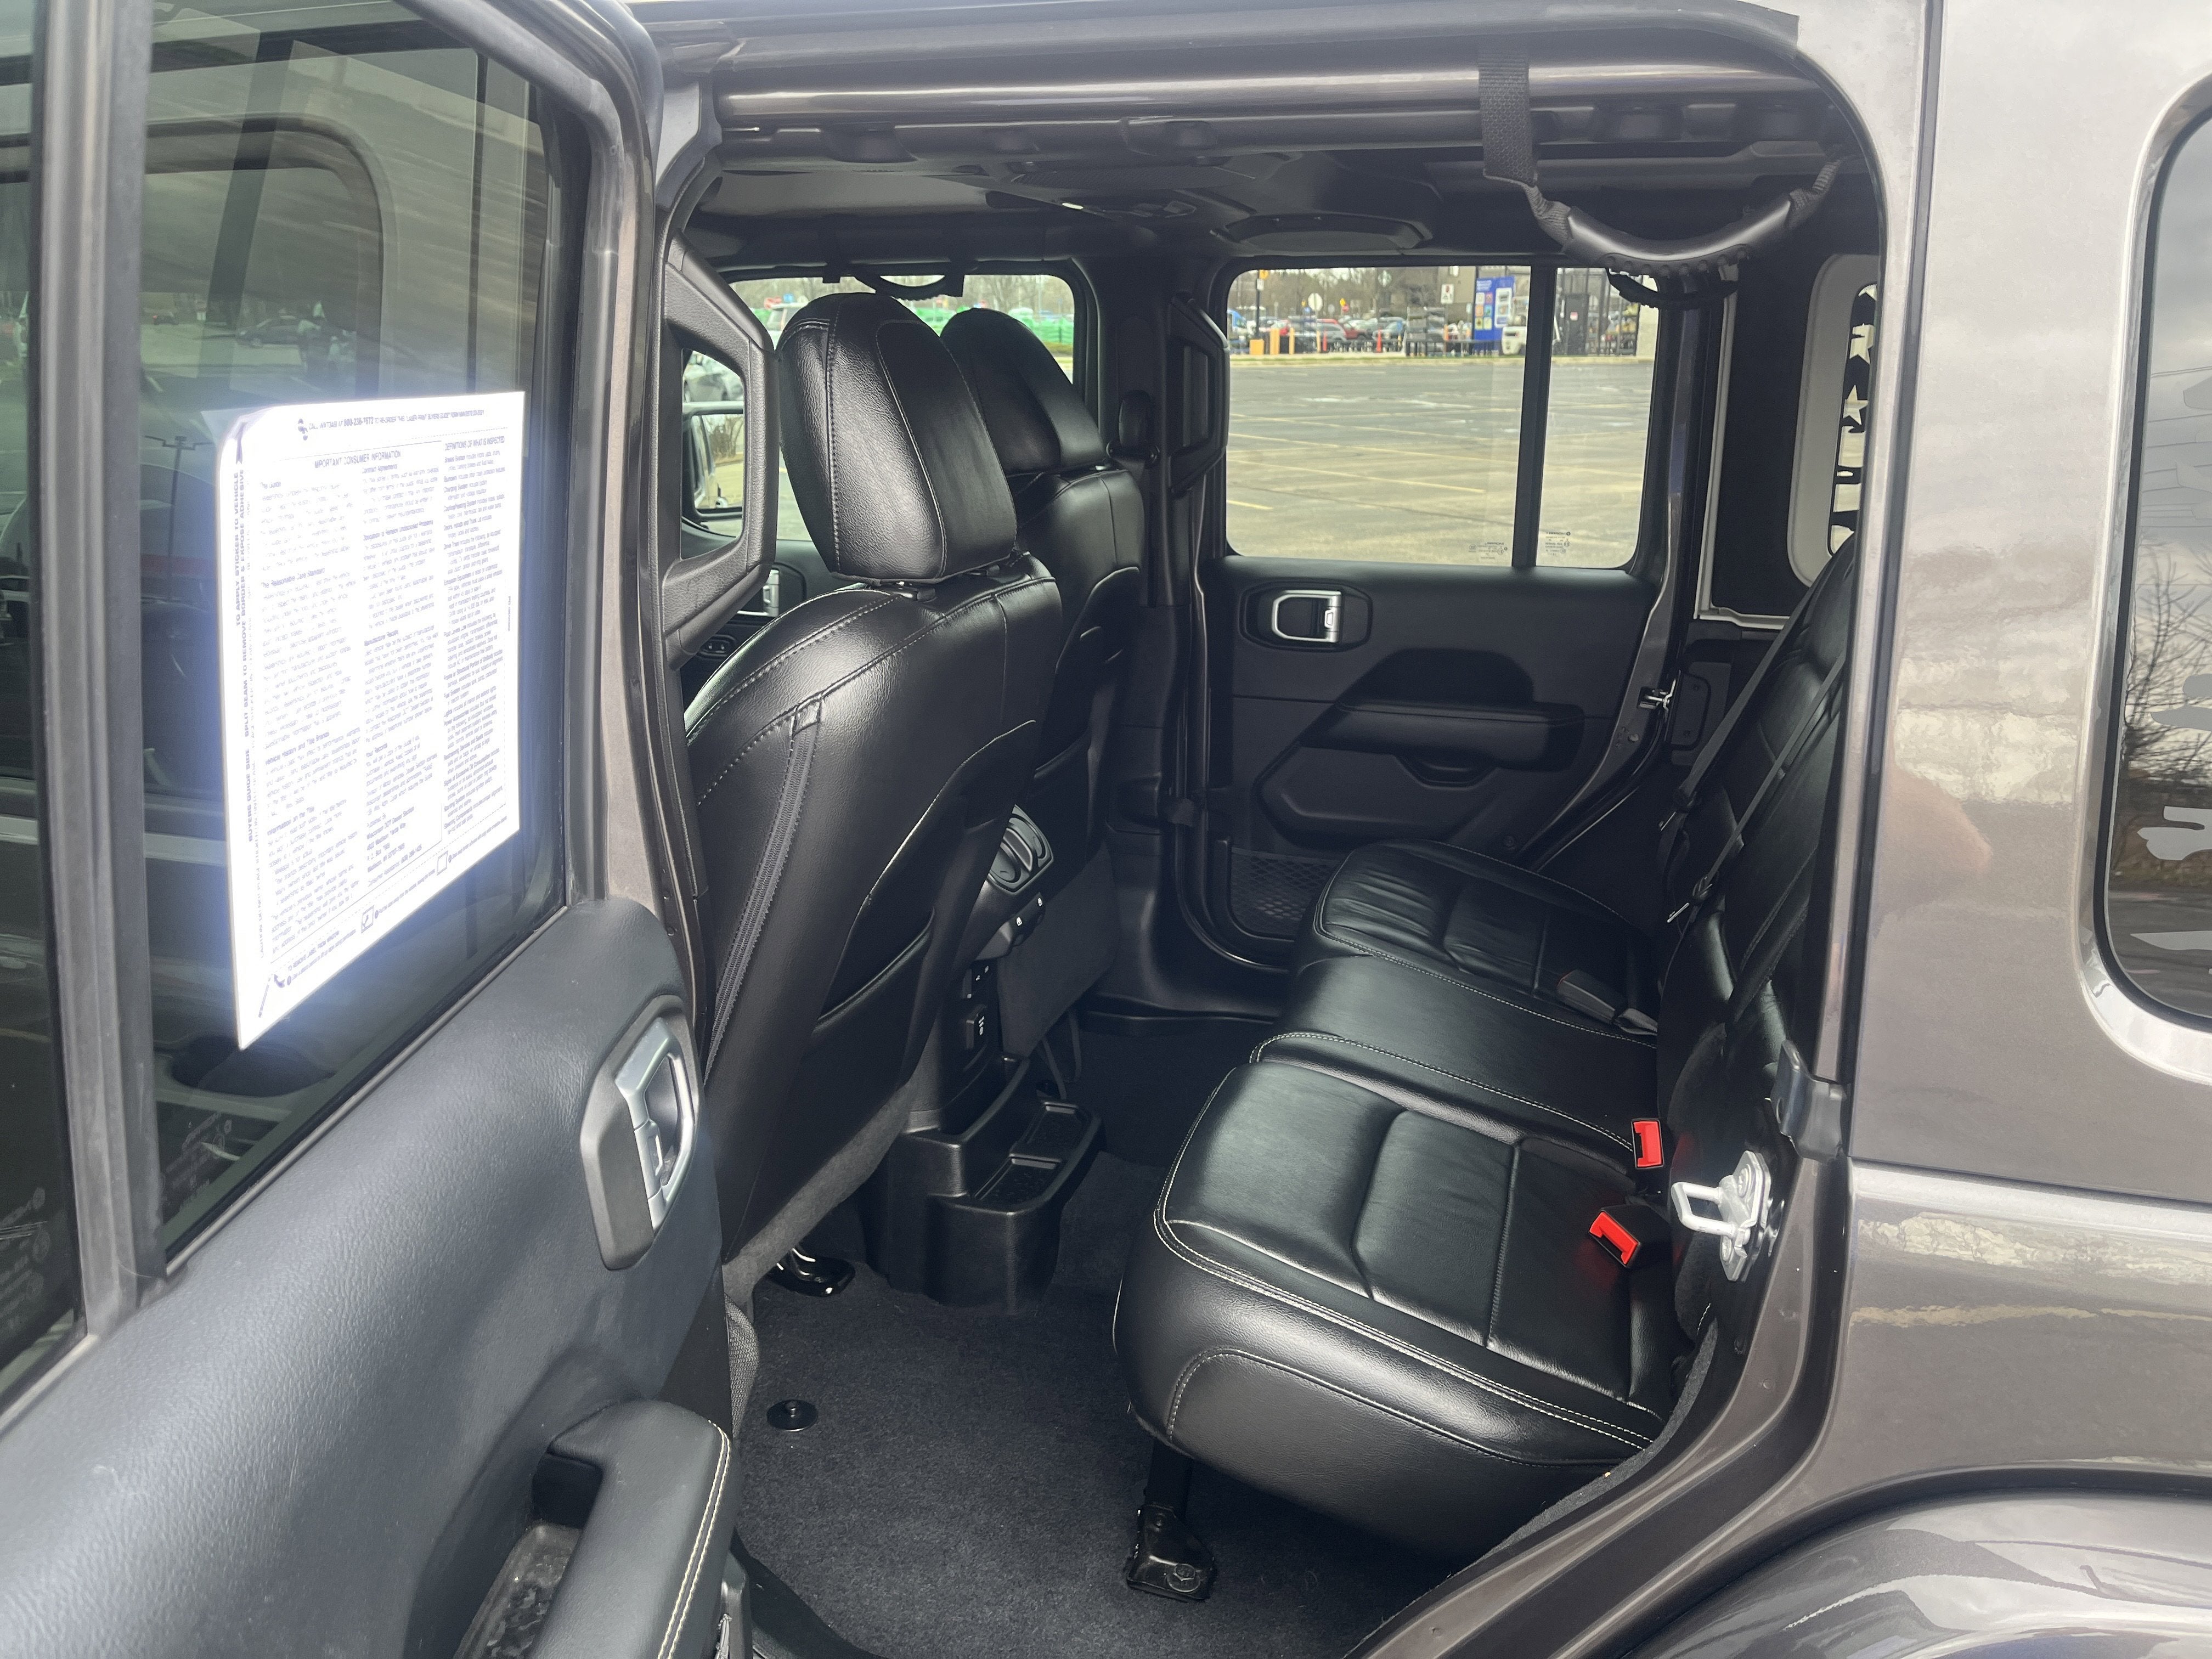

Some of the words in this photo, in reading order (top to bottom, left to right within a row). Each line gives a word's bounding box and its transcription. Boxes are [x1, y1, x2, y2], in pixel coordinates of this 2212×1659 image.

[344, 417, 374, 426] 800-236-7672
[473, 438, 483, 447] WHAT
[487, 436, 505, 444] INSPECTED
[314, 458, 341, 468] IMPORTANT
[344, 454, 369, 465] CONSUMER
[371, 450, 400, 460] INFORMATION
[234, 518, 239, 531] TO
[236, 614, 240, 626] TO
[242, 665, 247, 675] TO
